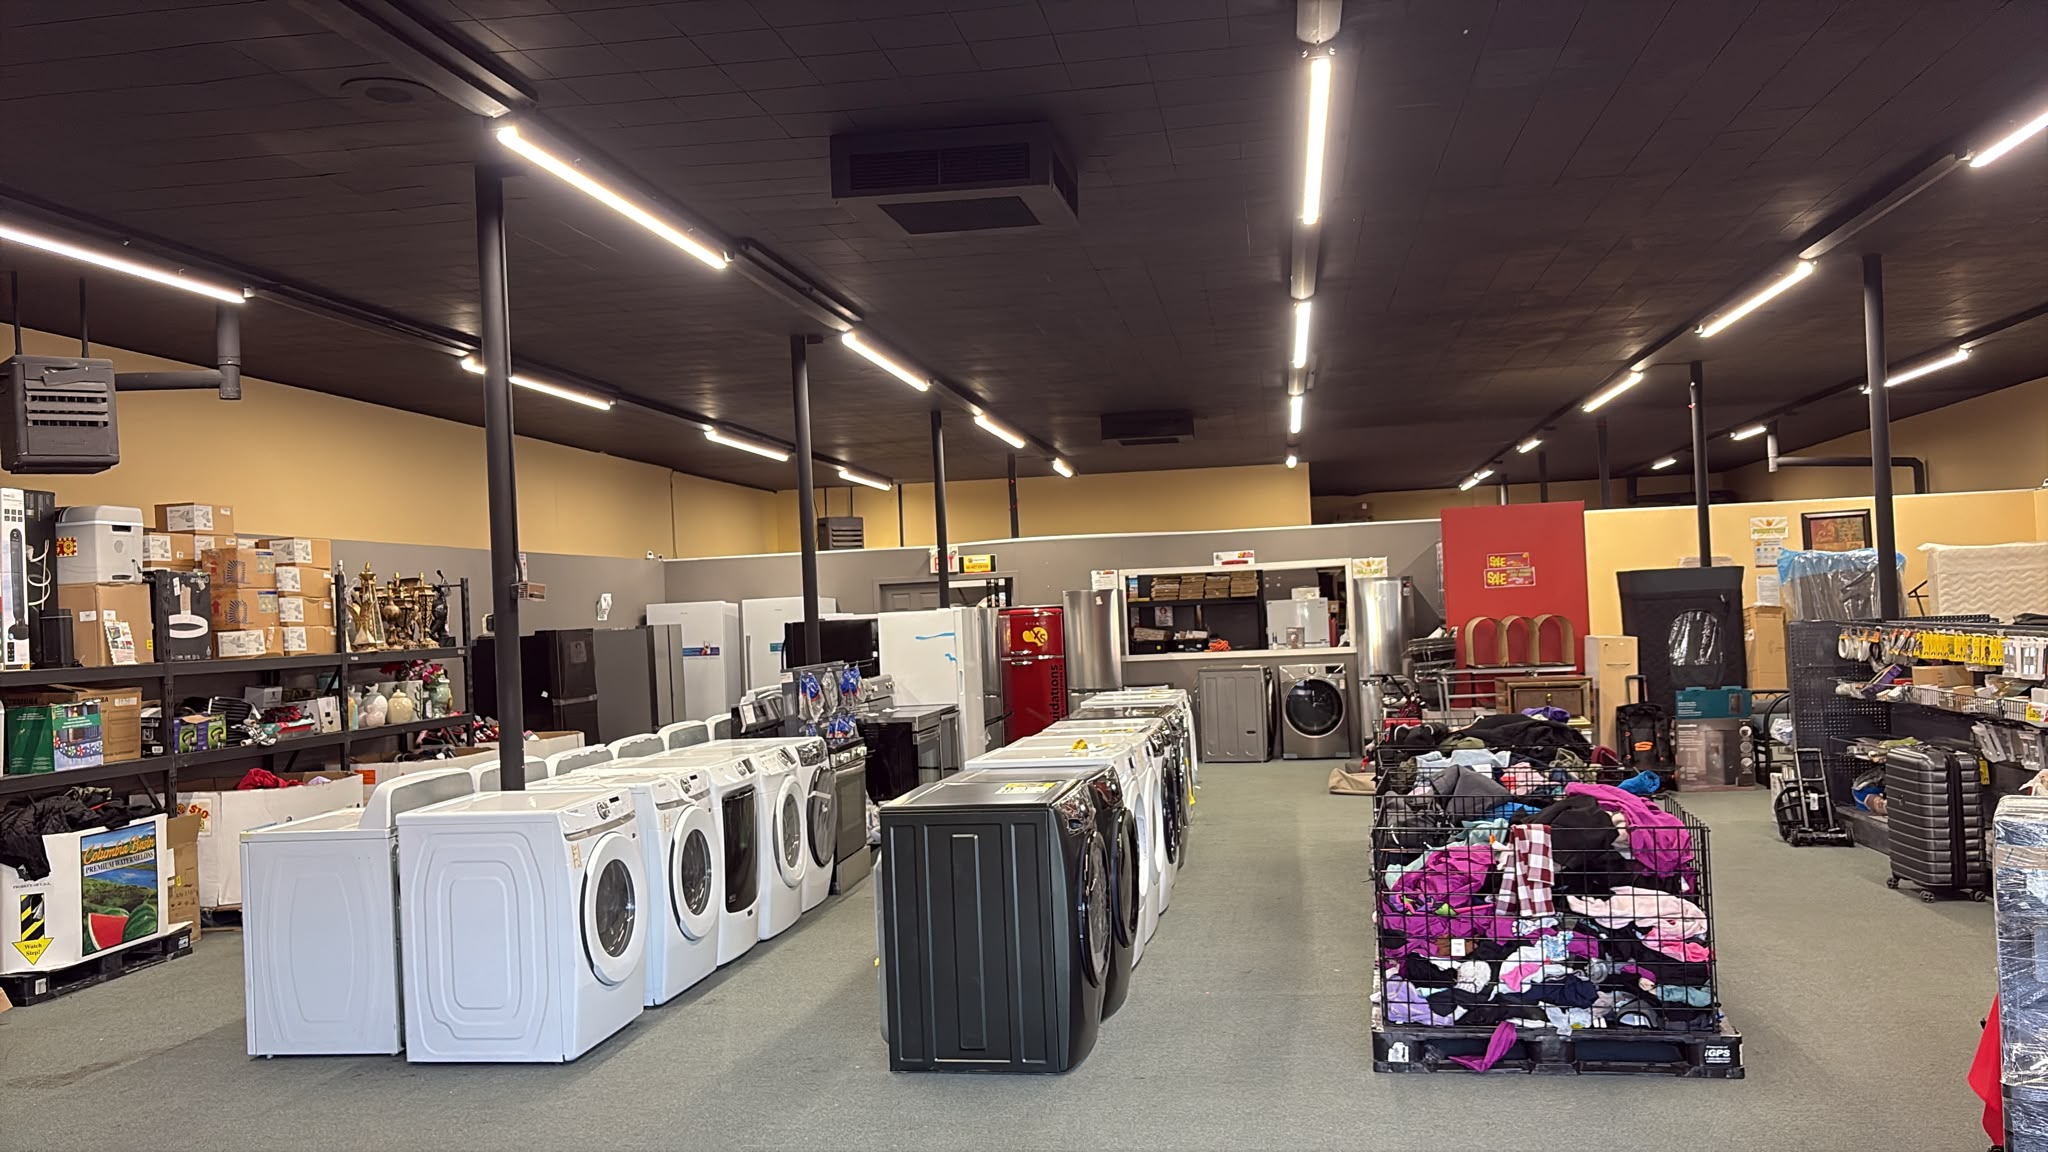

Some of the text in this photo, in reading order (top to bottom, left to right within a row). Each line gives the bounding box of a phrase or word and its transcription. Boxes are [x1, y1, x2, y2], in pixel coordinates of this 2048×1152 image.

[1490, 556, 1507, 567] SALE
[1487, 572, 1507, 585] SALE
[84, 835, 155, 865] Columbia Basin
[85, 851, 154, 873] PREMIUM WATERMELONS
[1704, 1049, 1730, 1057] iGPS
